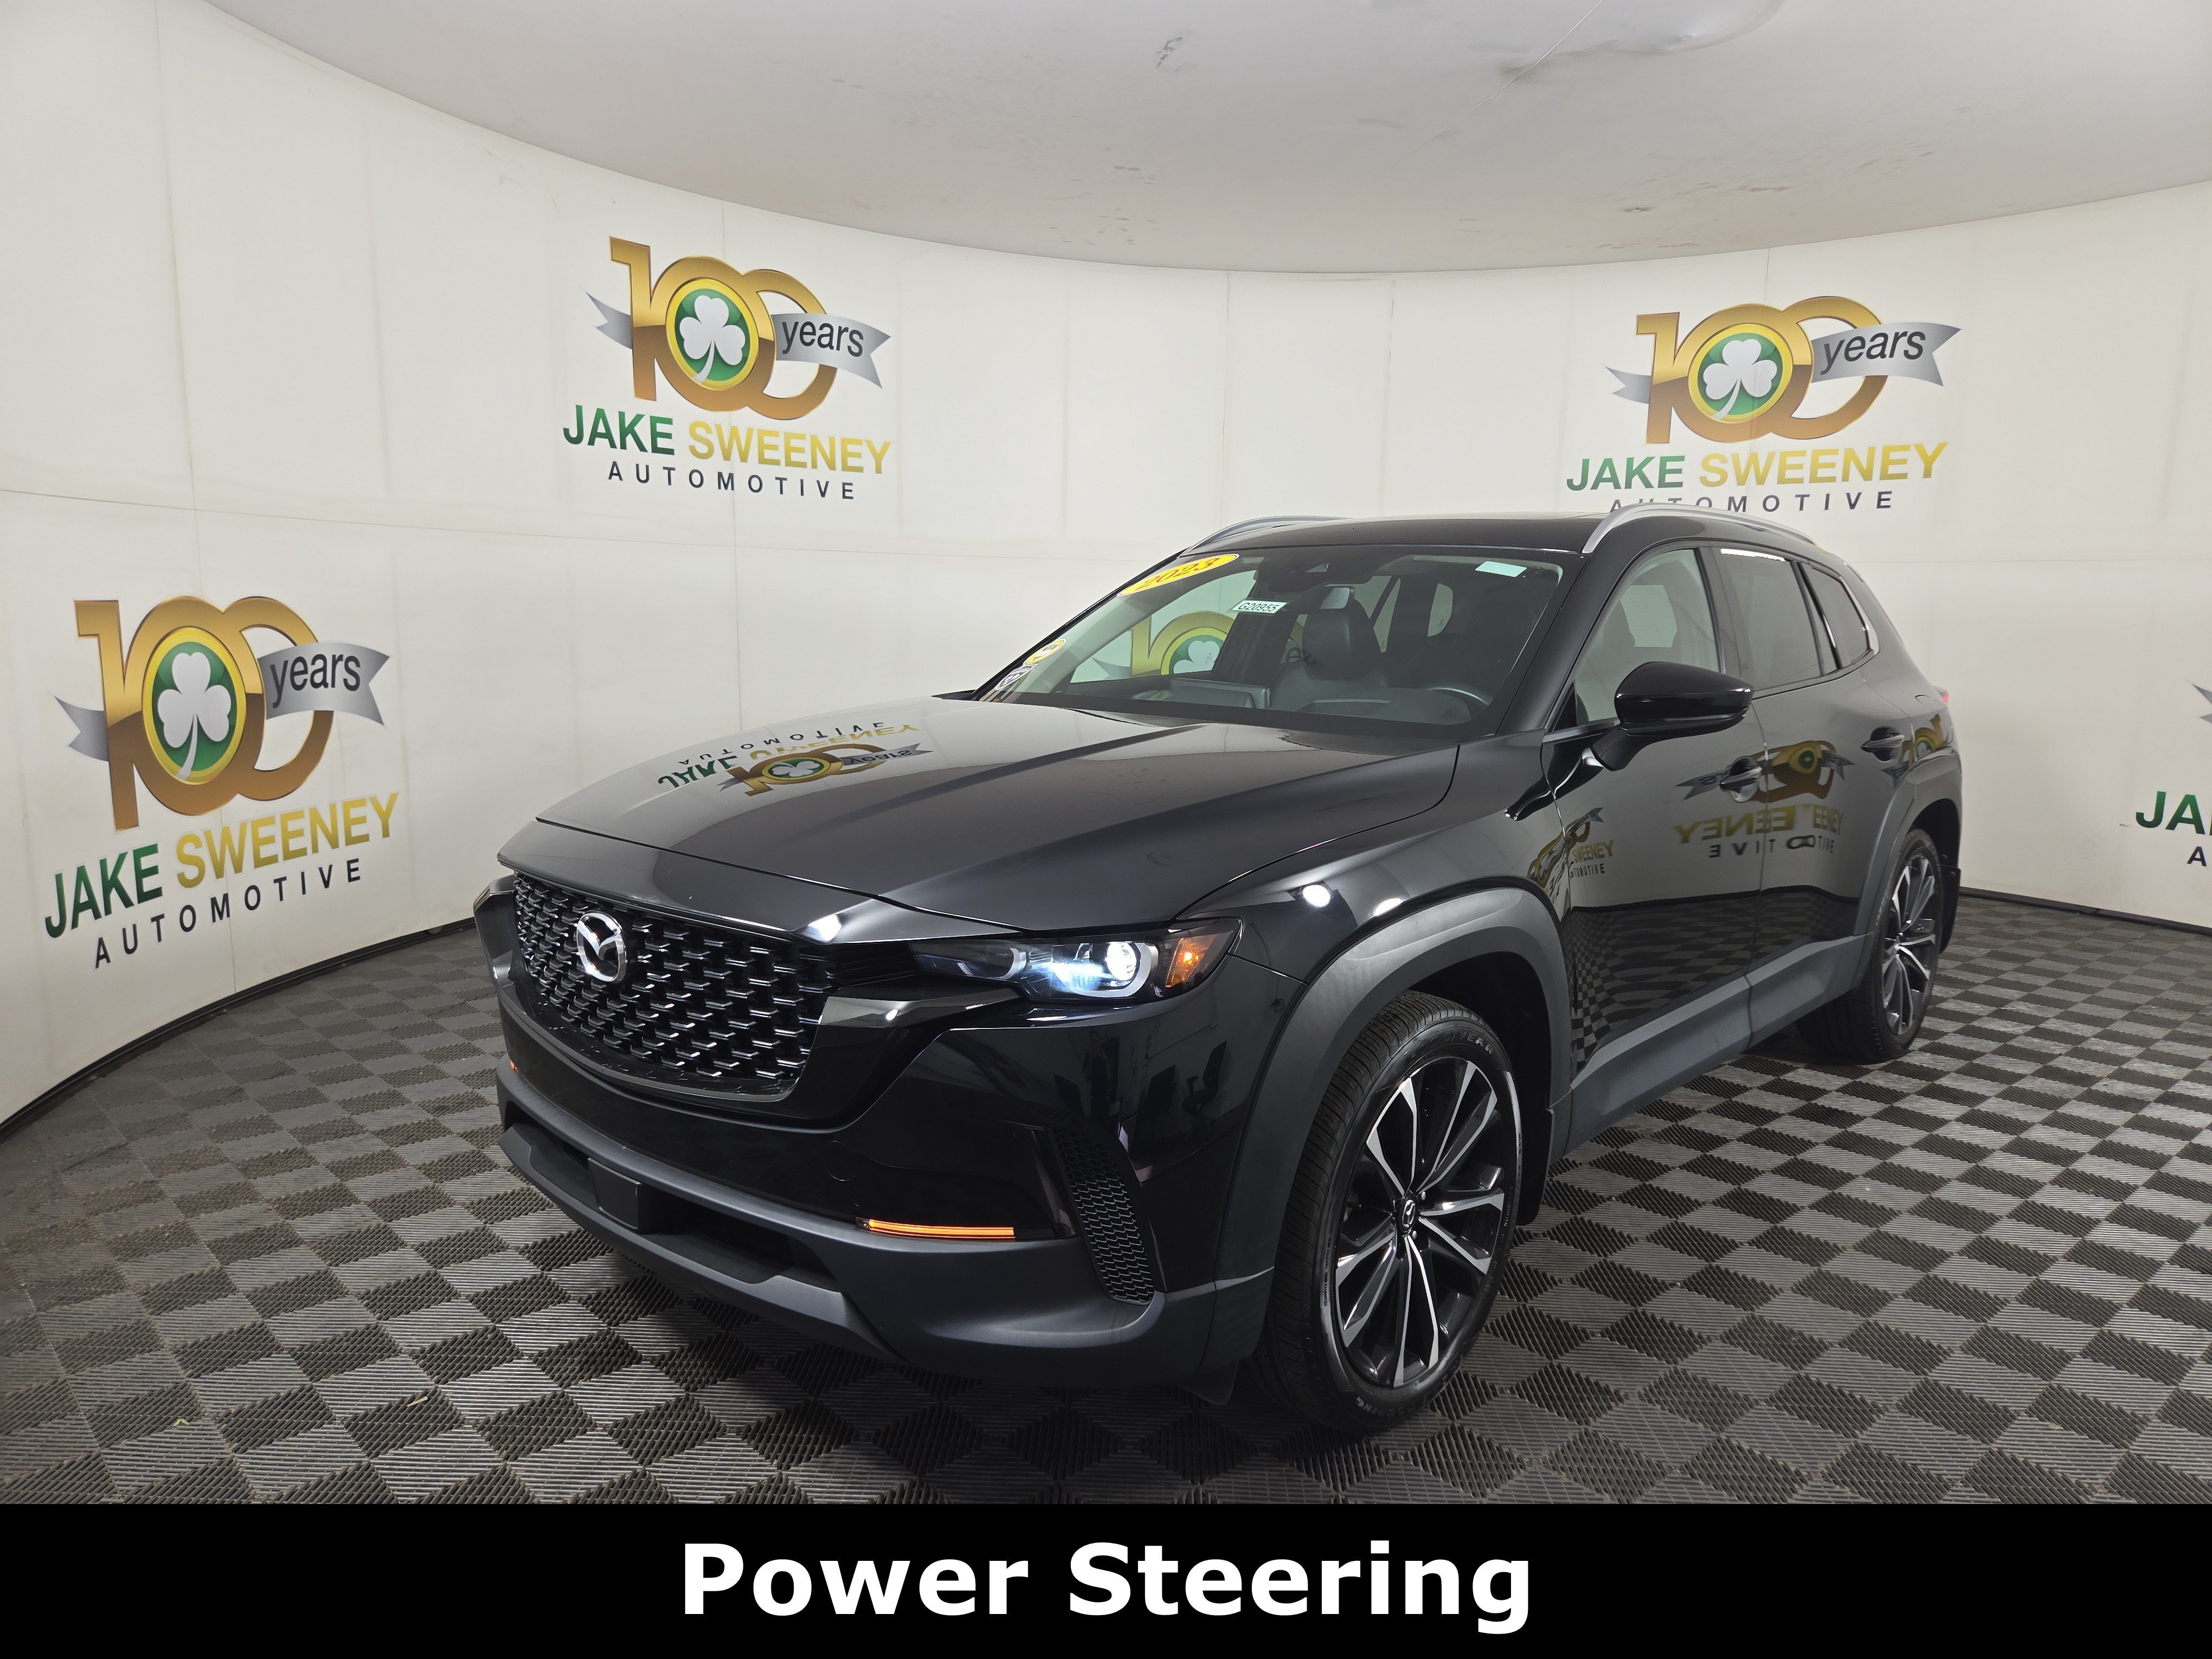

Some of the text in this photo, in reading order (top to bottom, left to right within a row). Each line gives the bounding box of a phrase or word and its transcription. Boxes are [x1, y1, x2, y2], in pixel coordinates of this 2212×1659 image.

[609, 236, 838, 420] 100
[781, 319, 864, 357] years
[1821, 330, 1926, 376] years
[1636, 295, 1888, 445] 100
[563, 404, 891, 474] JAKE SWEENEY
[608, 461, 854, 499] AUTOMOTIVE
[1566, 442, 1949, 491] JAKE SWEENEY
[1135, 557, 1220, 591] 2023
[1238, 602, 1279, 612] G20955
[270, 653, 361, 709] years
[74, 595, 335, 832] 100
[2136, 791, 2212, 836] JA
[44, 793, 399, 938] JAKE SWEENEY
[95, 858, 361, 968] AUTOMOTIVE
